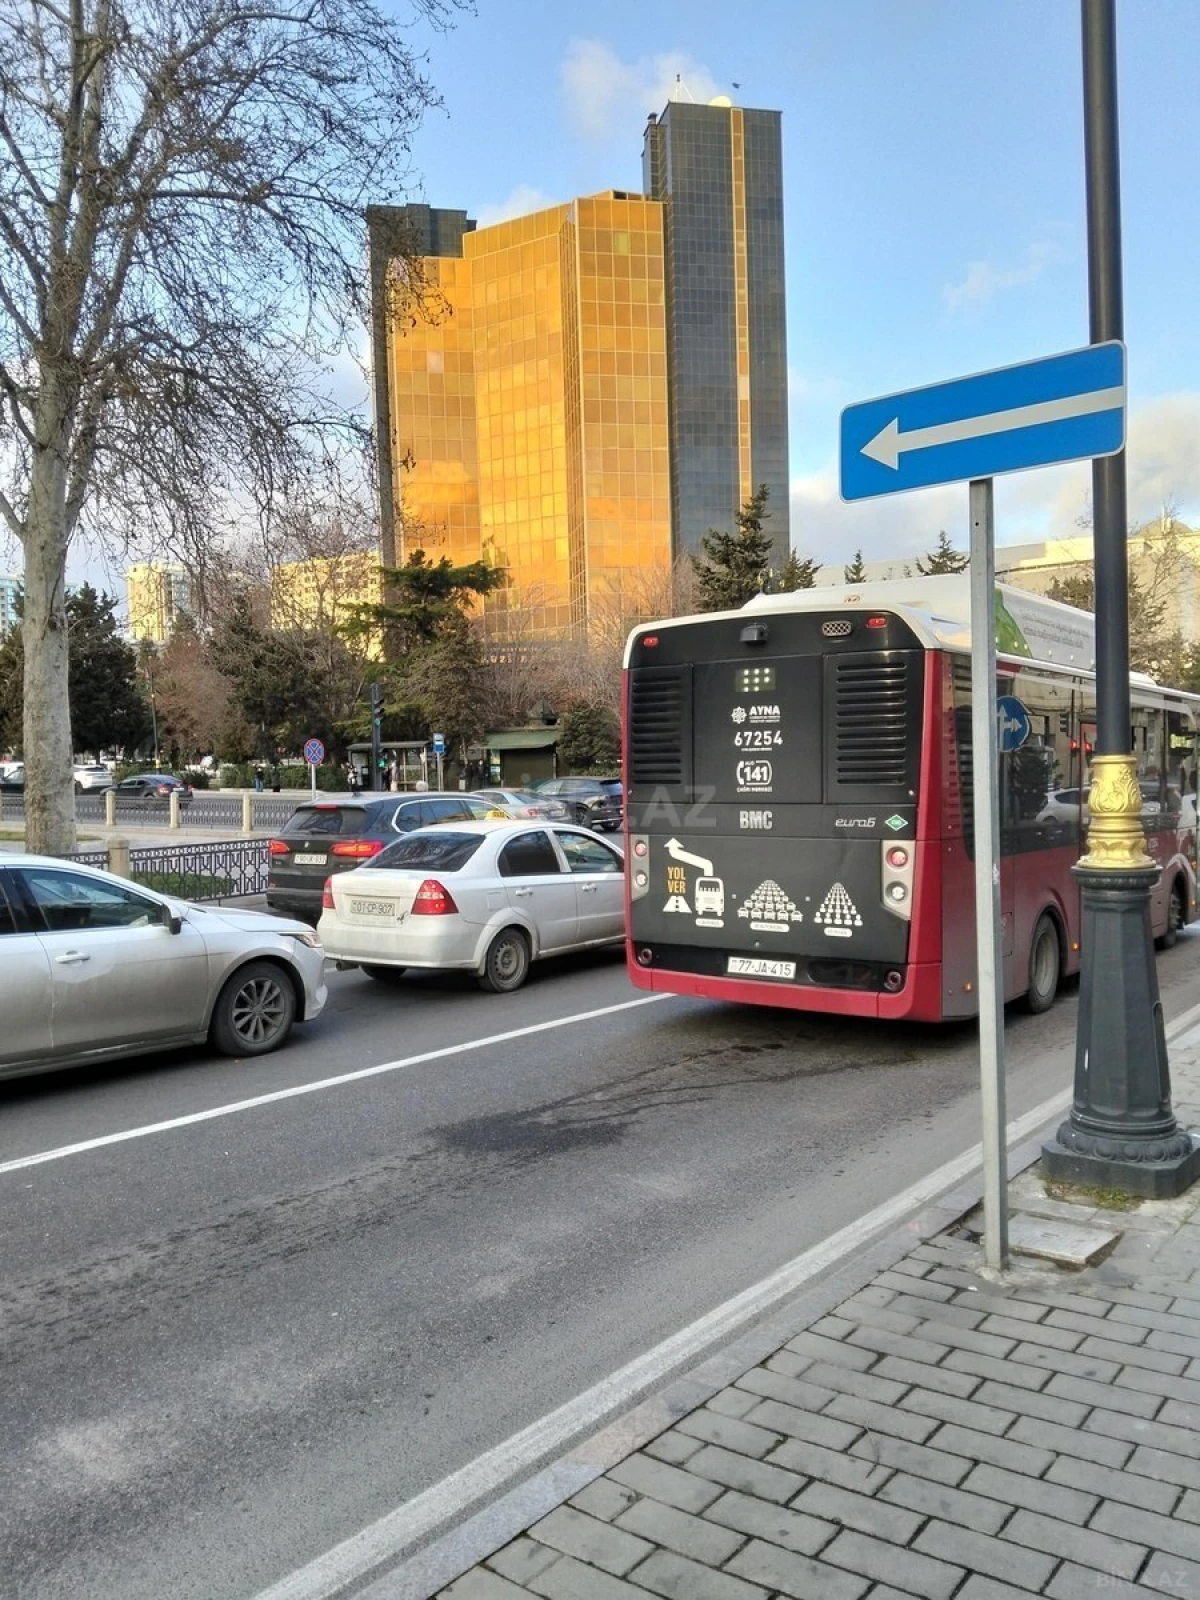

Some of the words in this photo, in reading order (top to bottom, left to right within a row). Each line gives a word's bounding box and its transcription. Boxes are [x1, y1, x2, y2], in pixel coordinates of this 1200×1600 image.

[748, 705, 781, 716] AYNA
[734, 730, 783, 746] 67254
[744, 766, 768, 781] 141
[739, 811, 773, 830] BMC
[667, 866, 686, 880] YOL
[667, 880, 686, 894] VER
[738, 959, 792, 976] 77-JA-415
